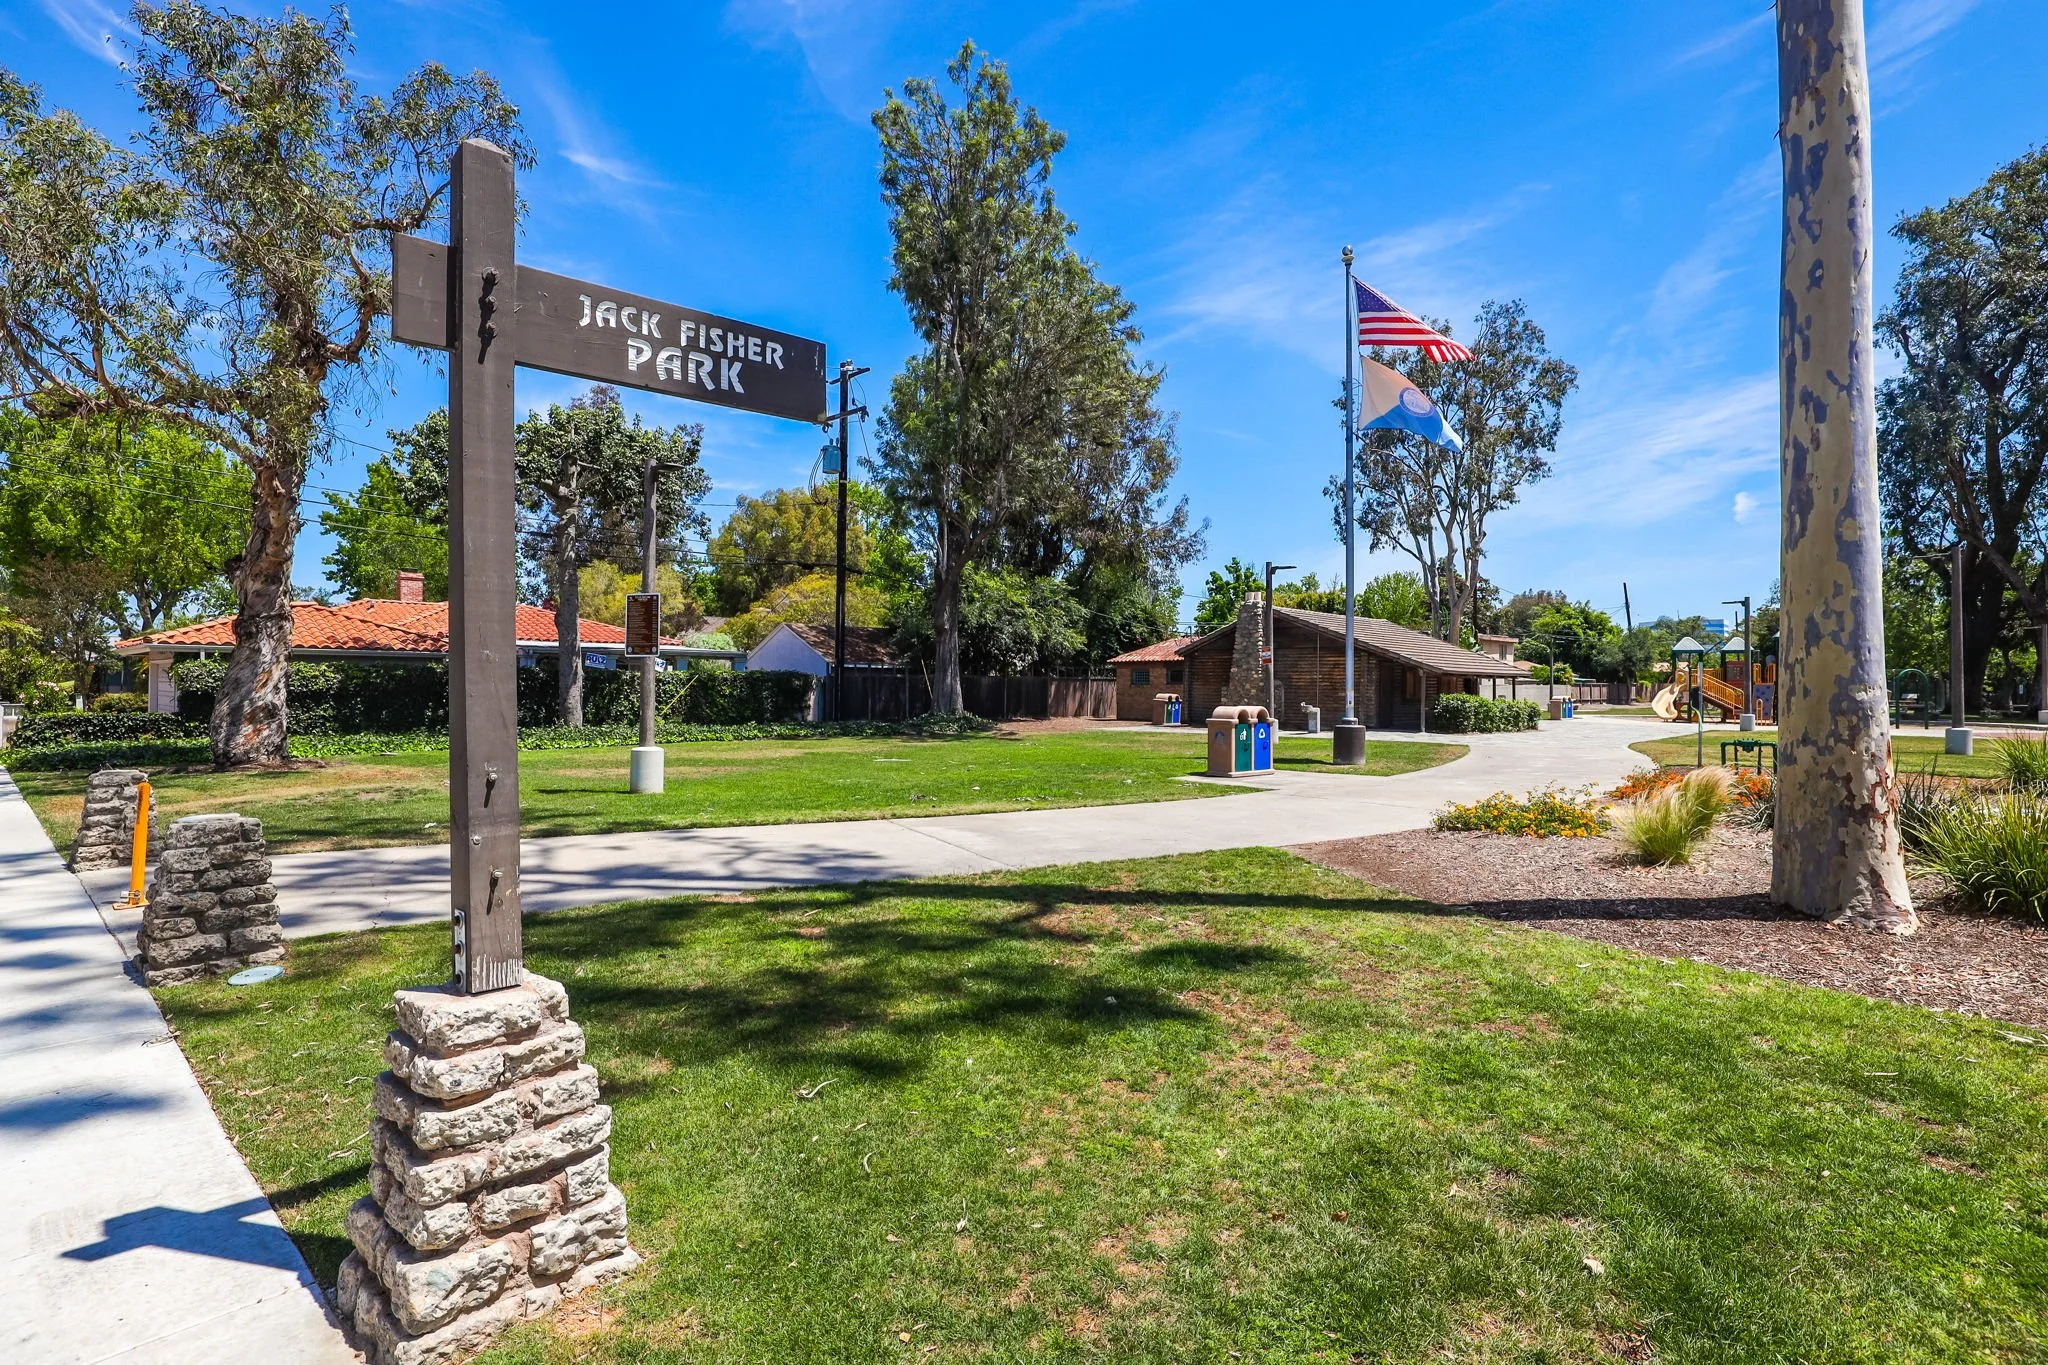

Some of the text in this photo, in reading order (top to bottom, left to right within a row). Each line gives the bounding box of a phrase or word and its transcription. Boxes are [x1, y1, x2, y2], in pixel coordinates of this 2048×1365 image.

[578, 294, 785, 370] JACK FISHER
[626, 337, 745, 394] PARK
